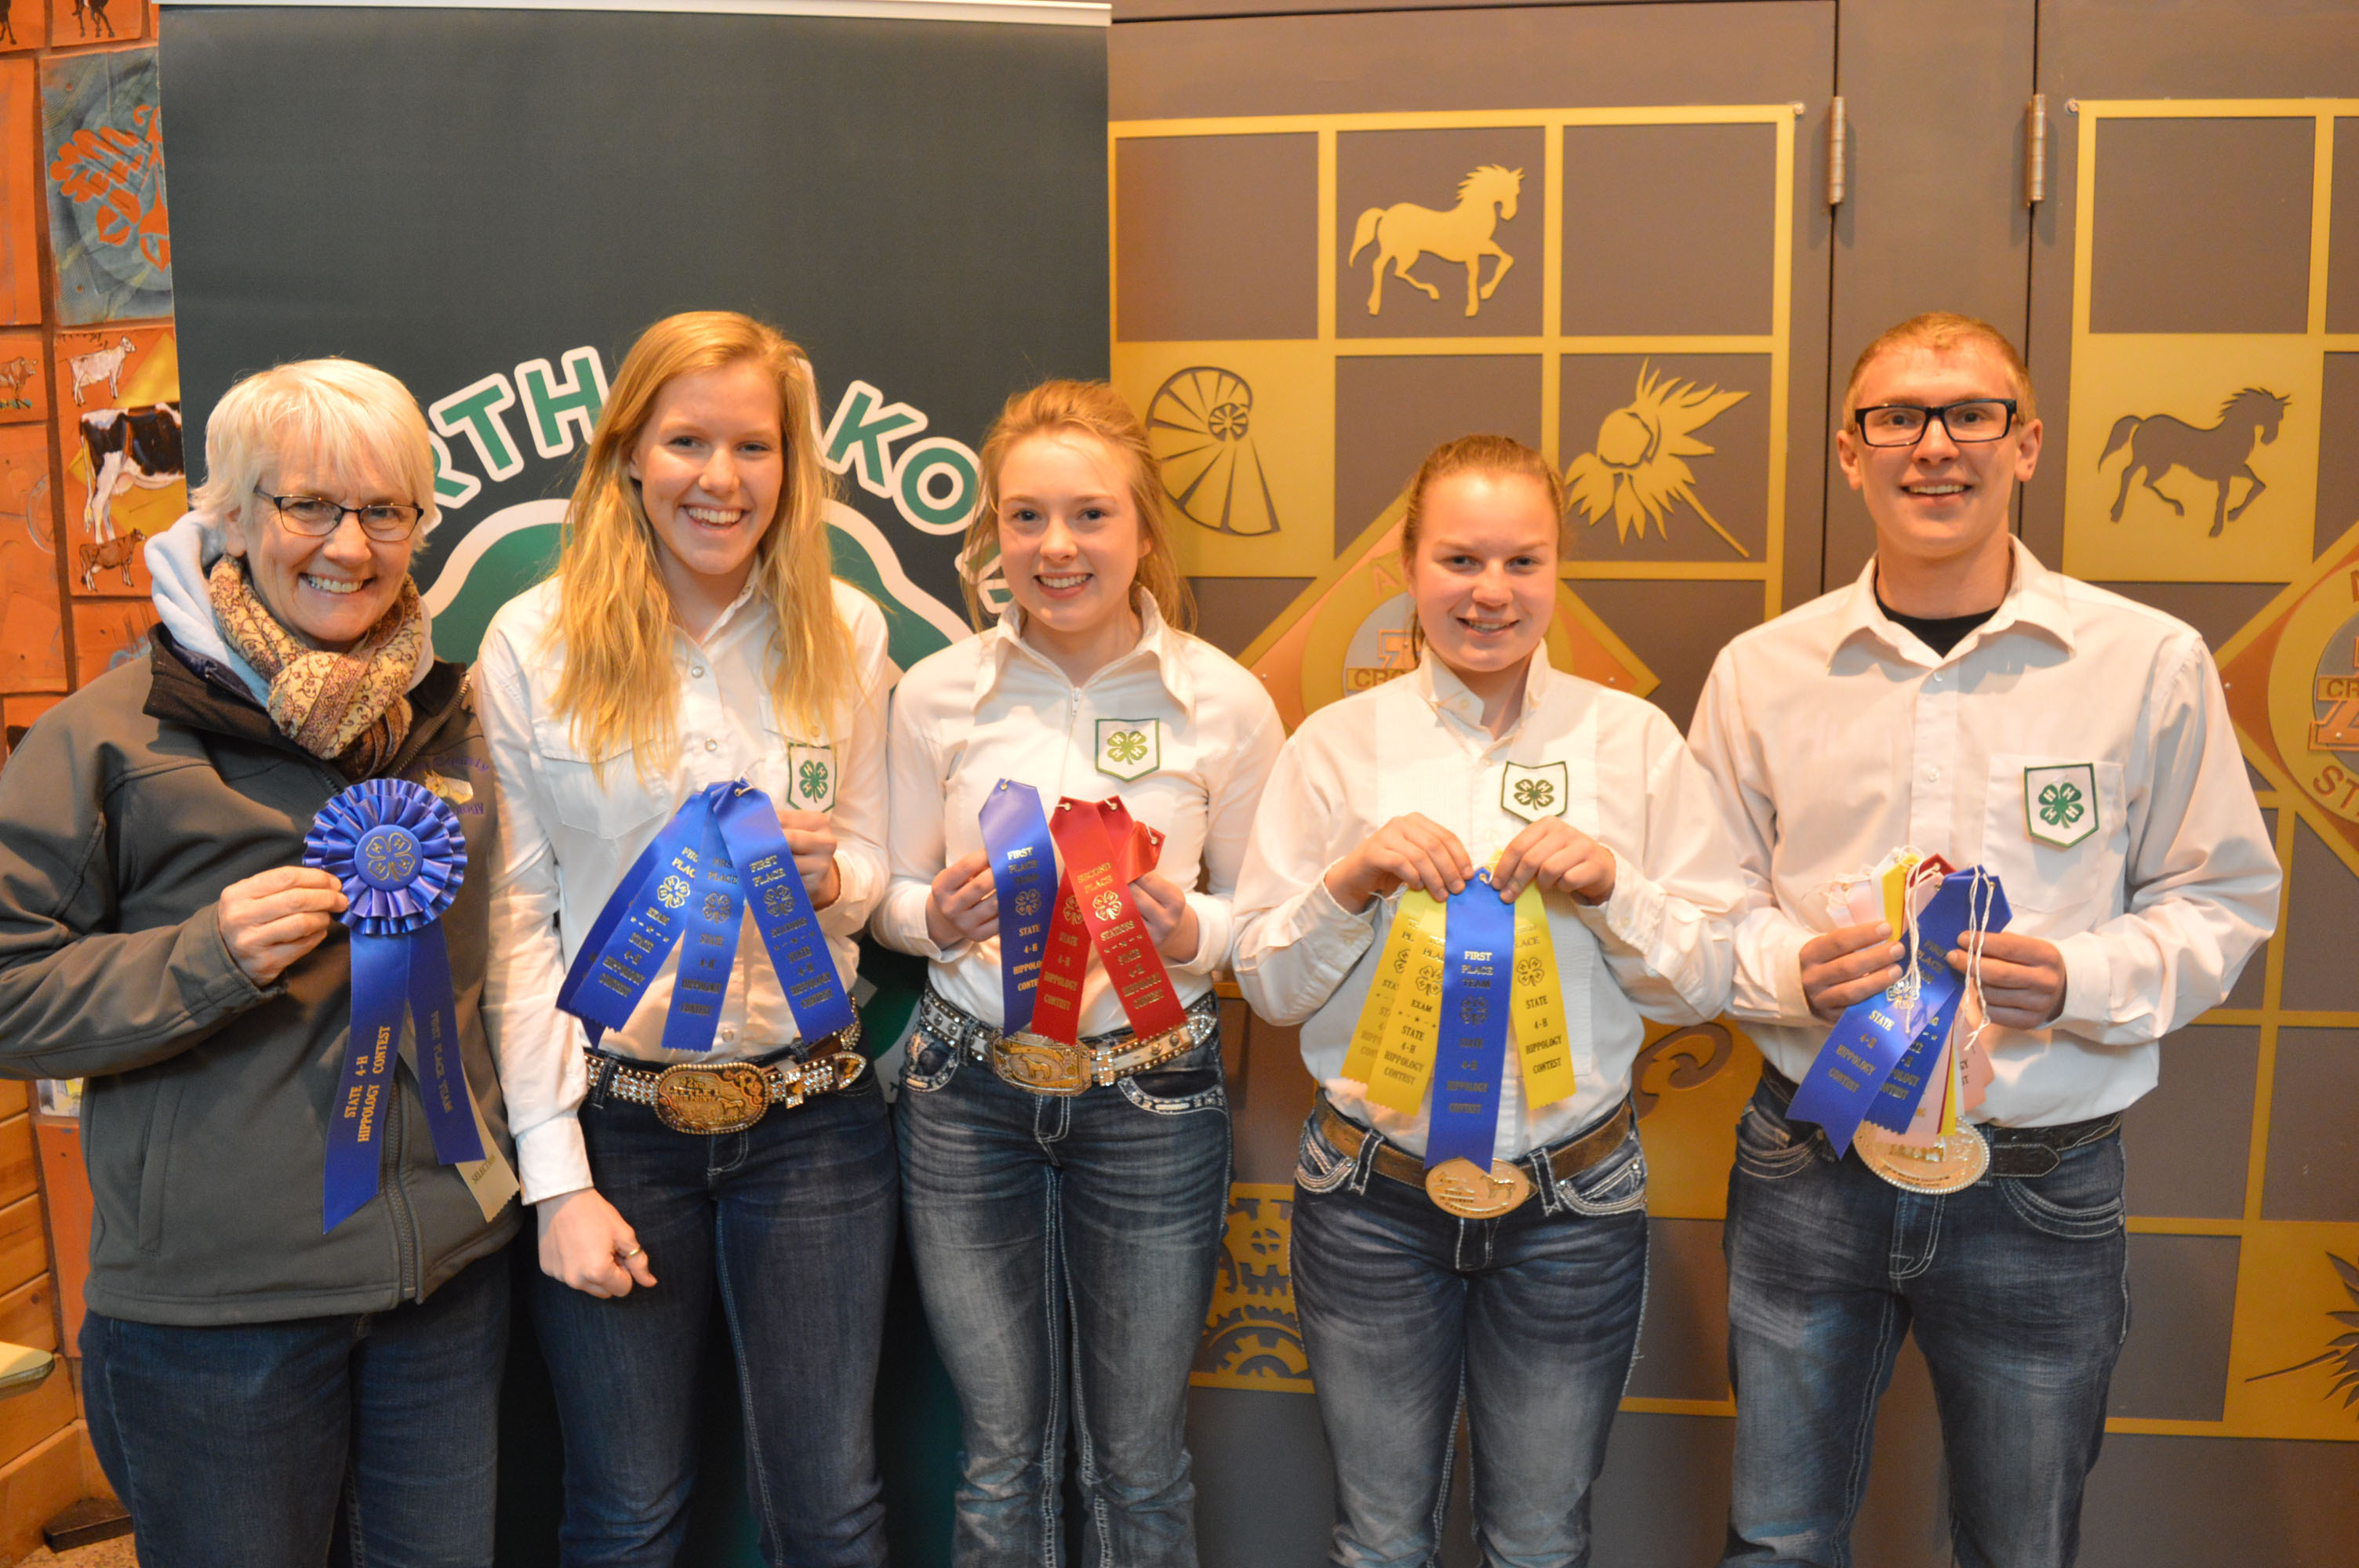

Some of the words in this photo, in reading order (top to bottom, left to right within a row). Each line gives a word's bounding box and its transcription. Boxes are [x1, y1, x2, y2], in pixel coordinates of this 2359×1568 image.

[431, 346, 611, 508] RTH
[1007, 847, 1033, 861] FIRST
[671, 857, 696, 878] PLAC
[750, 855, 778, 873] FIRST
[1008, 860, 1038, 874] PLACE
[752, 868, 786, 887] PLACE
[1078, 862, 1112, 884] SECOND
[1084, 875, 1114, 895] PLACE
[1019, 924, 1041, 937] STATE
[1023, 943, 1038, 953] 4-H
[1514, 936, 1540, 949] LACE
[1464, 950, 1492, 961] FIRST
[1461, 964, 1494, 975] PLACE
[1044, 971, 1078, 991] HIPPOLOGY
[1462, 978, 1491, 989] TEAM
[1044, 993, 1071, 1011] CONTEST
[1412, 999, 1433, 1013] EXAM
[1526, 996, 1548, 1010] STATE
[1534, 1018, 1548, 1029] 4-H
[1869, 1010, 1895, 1032] STATE
[1401, 1025, 1425, 1041] STATE
[1859, 1033, 1877, 1049] 4-H
[1401, 1042, 1416, 1054] 4-H
[1459, 1038, 1483, 1048] STATE
[1525, 1035, 1562, 1054] HIPPOLOGY
[1384, 1051, 1424, 1073] HIPPOLOGY
[1462, 1060, 1478, 1070] 4-H
[1533, 1058, 1561, 1074] CONTEST
[1836, 1044, 1876, 1076] HIPPOLOGY
[358, 1085, 380, 1142] HIPPOLOGY
[373, 1025, 391, 1074] CONTEST
[1383, 1066, 1416, 1086] CONTEST
[1828, 1067, 1860, 1094] CONTEST
[344, 1085, 363, 1118] STATE
[355, 1055, 369, 1076] 4-H
[1446, 1080, 1488, 1093] HIPPOLOGY
[1448, 1102, 1481, 1113] CONTEST
